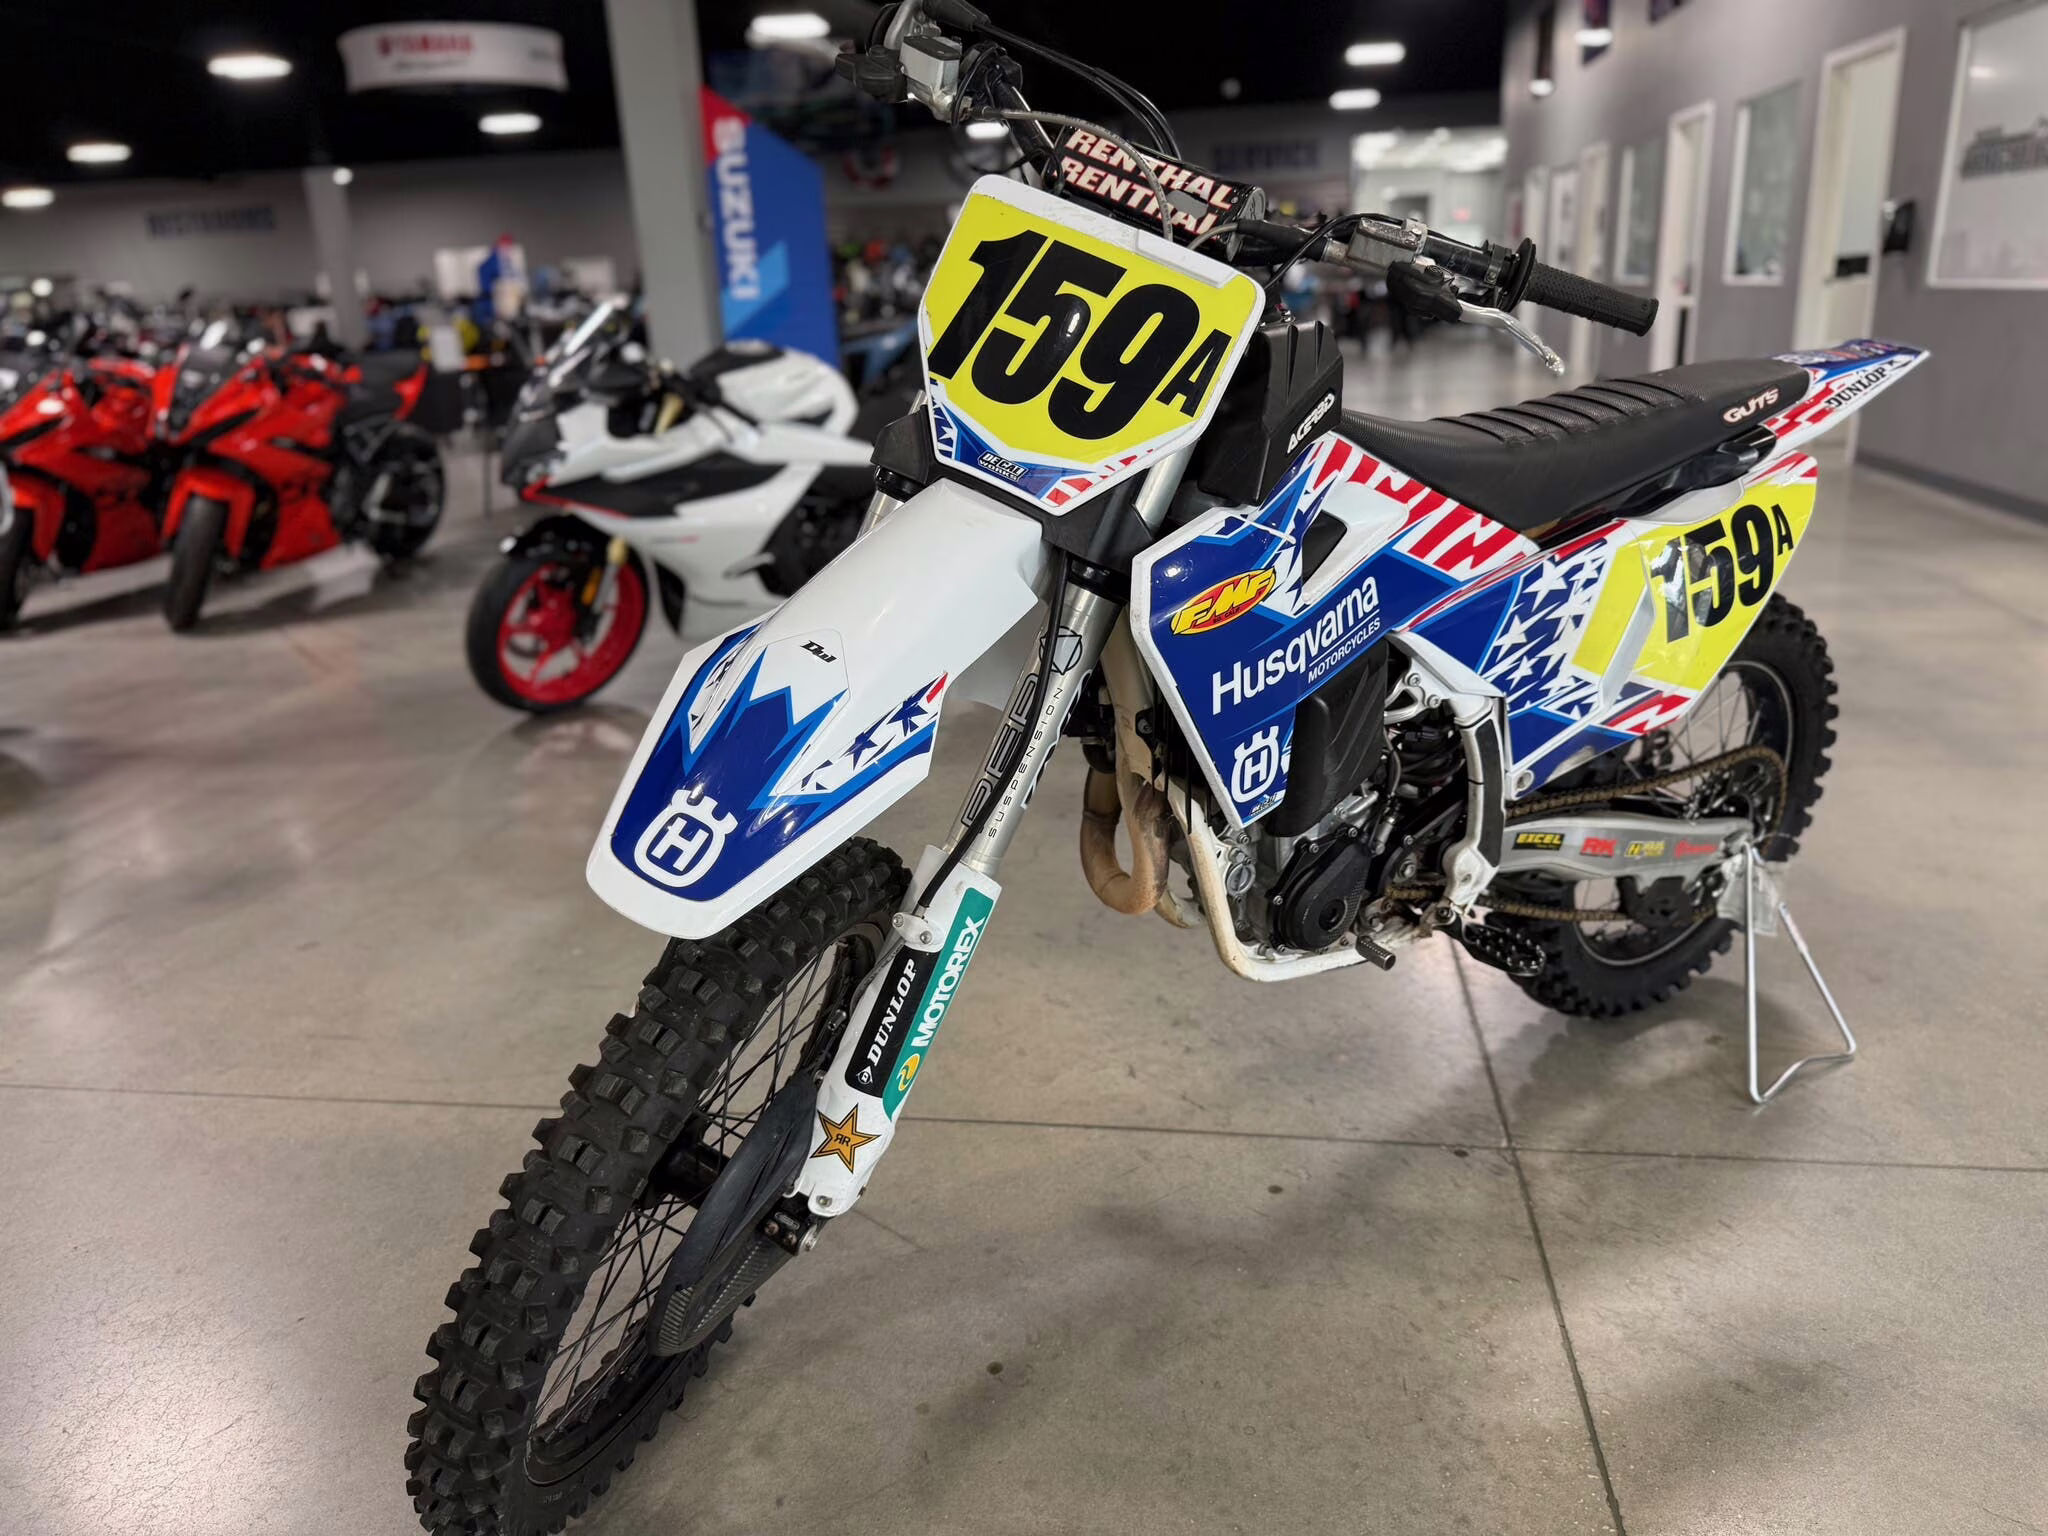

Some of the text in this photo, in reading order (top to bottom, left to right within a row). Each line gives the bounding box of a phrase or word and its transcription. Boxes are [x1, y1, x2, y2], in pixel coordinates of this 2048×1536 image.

[1064, 129, 1234, 212] RENTHAL
[713, 115, 760, 300] SUZUKI
[1723, 387, 1779, 424] GUTS
[1825, 366, 1888, 408] DUNLOP
[982, 453, 1025, 476] DECAL
[1173, 568, 1276, 635] FMF
[1212, 575, 1379, 716] Husqvarna
[1308, 616, 1381, 684] MOTORCYCLES
[988, 687, 1063, 838] SUSPENSION
[1516, 833, 1562, 845] EXCEL
[1581, 837, 1618, 857] RK
[866, 958, 916, 1067] DUNLOP
[911, 916, 985, 1048] MOTOREX
